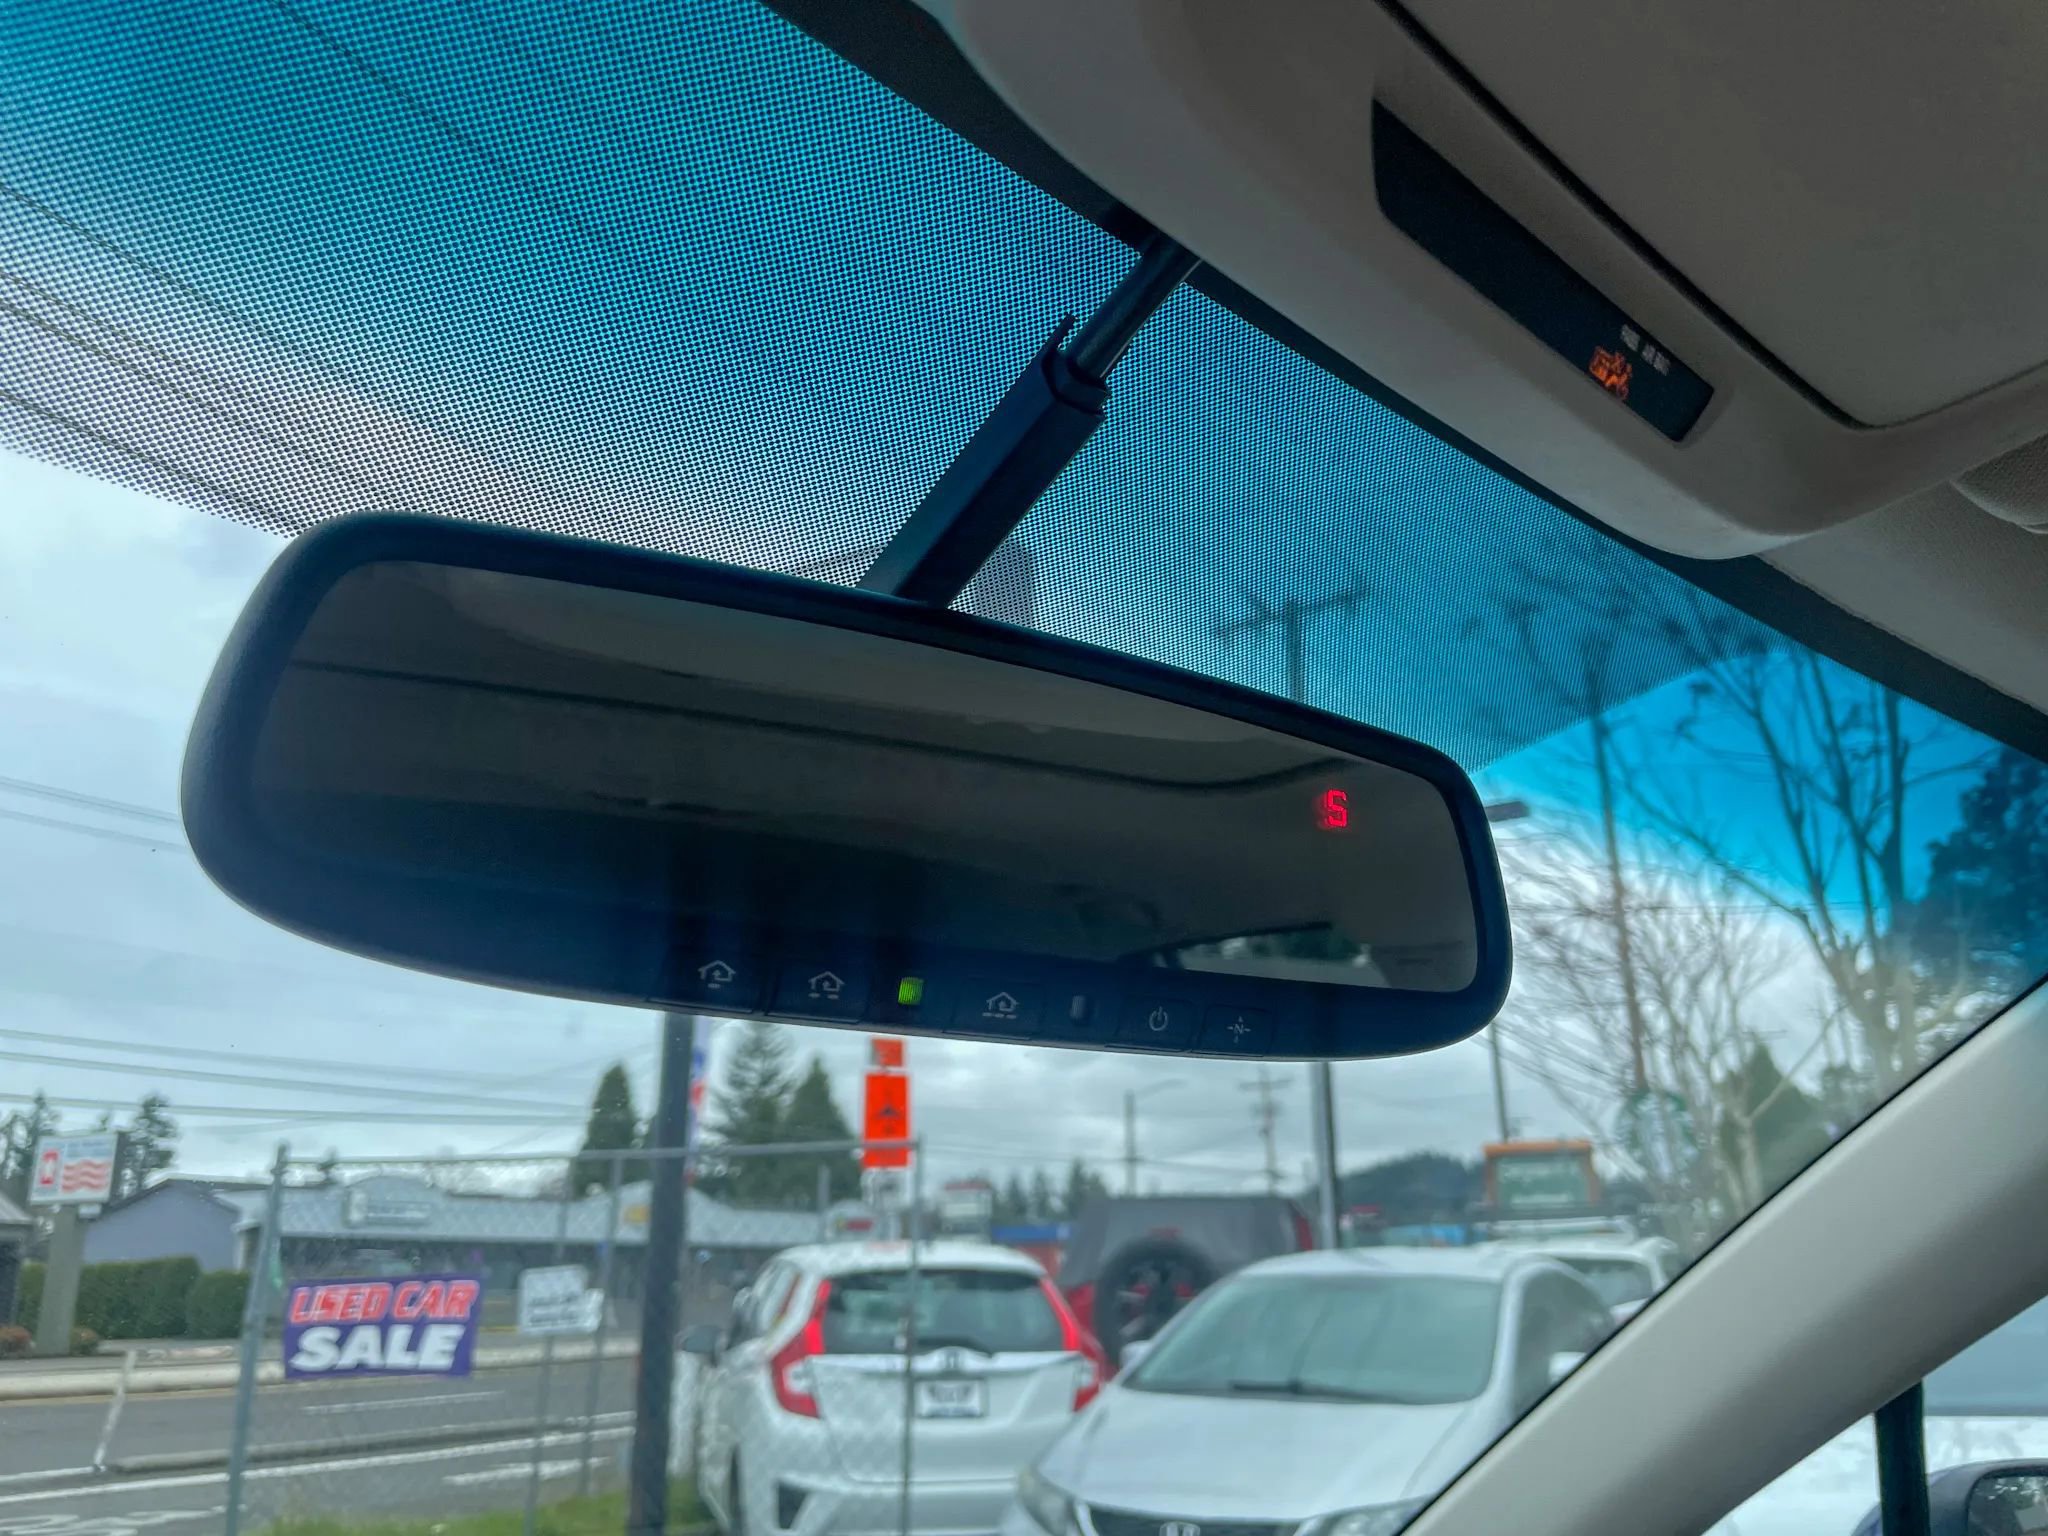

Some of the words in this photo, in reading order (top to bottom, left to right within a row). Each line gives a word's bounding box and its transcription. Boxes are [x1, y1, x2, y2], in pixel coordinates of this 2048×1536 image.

[290, 1282, 393, 1323] USED
[394, 1280, 480, 1320] CAR
[288, 1324, 466, 1371] SALE
